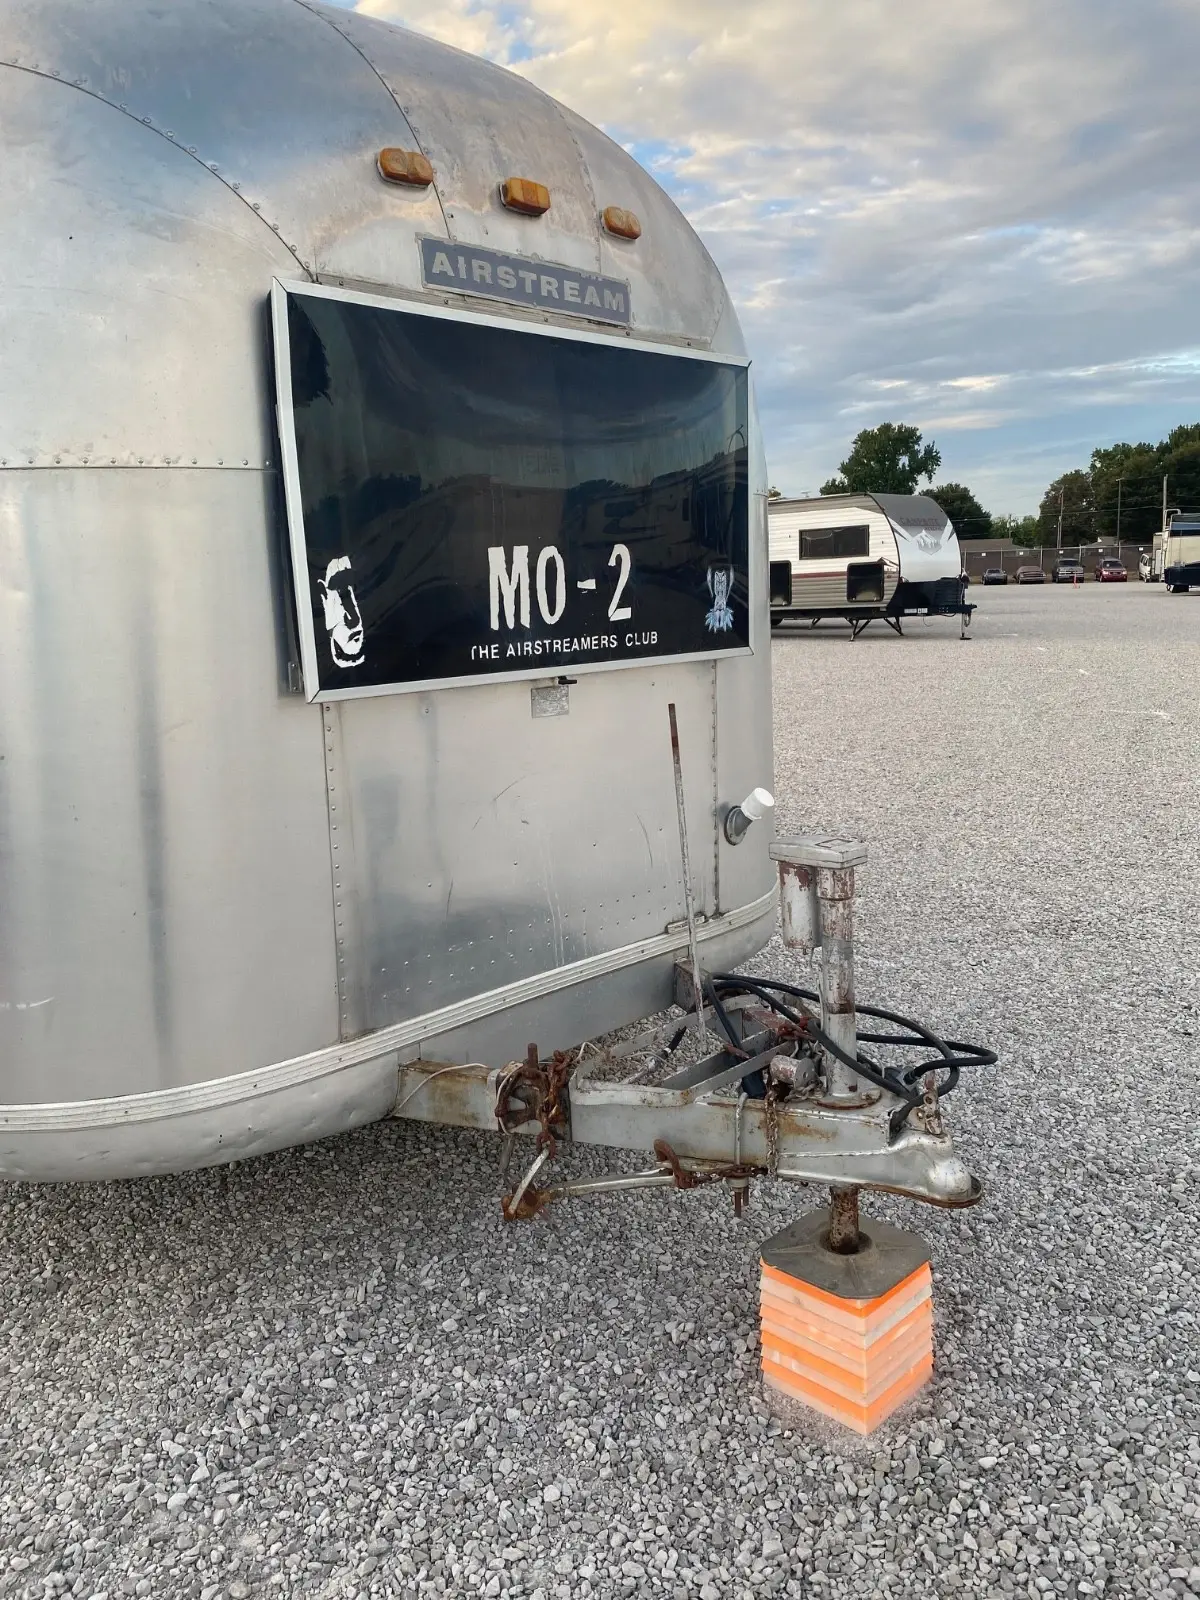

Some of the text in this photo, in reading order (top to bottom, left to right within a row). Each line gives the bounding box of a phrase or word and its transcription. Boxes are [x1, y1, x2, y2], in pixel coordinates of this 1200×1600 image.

[431, 251, 625, 313] AIRSTREAM
[471, 630, 658, 660] THE AIRSTREAMERS CLUB
